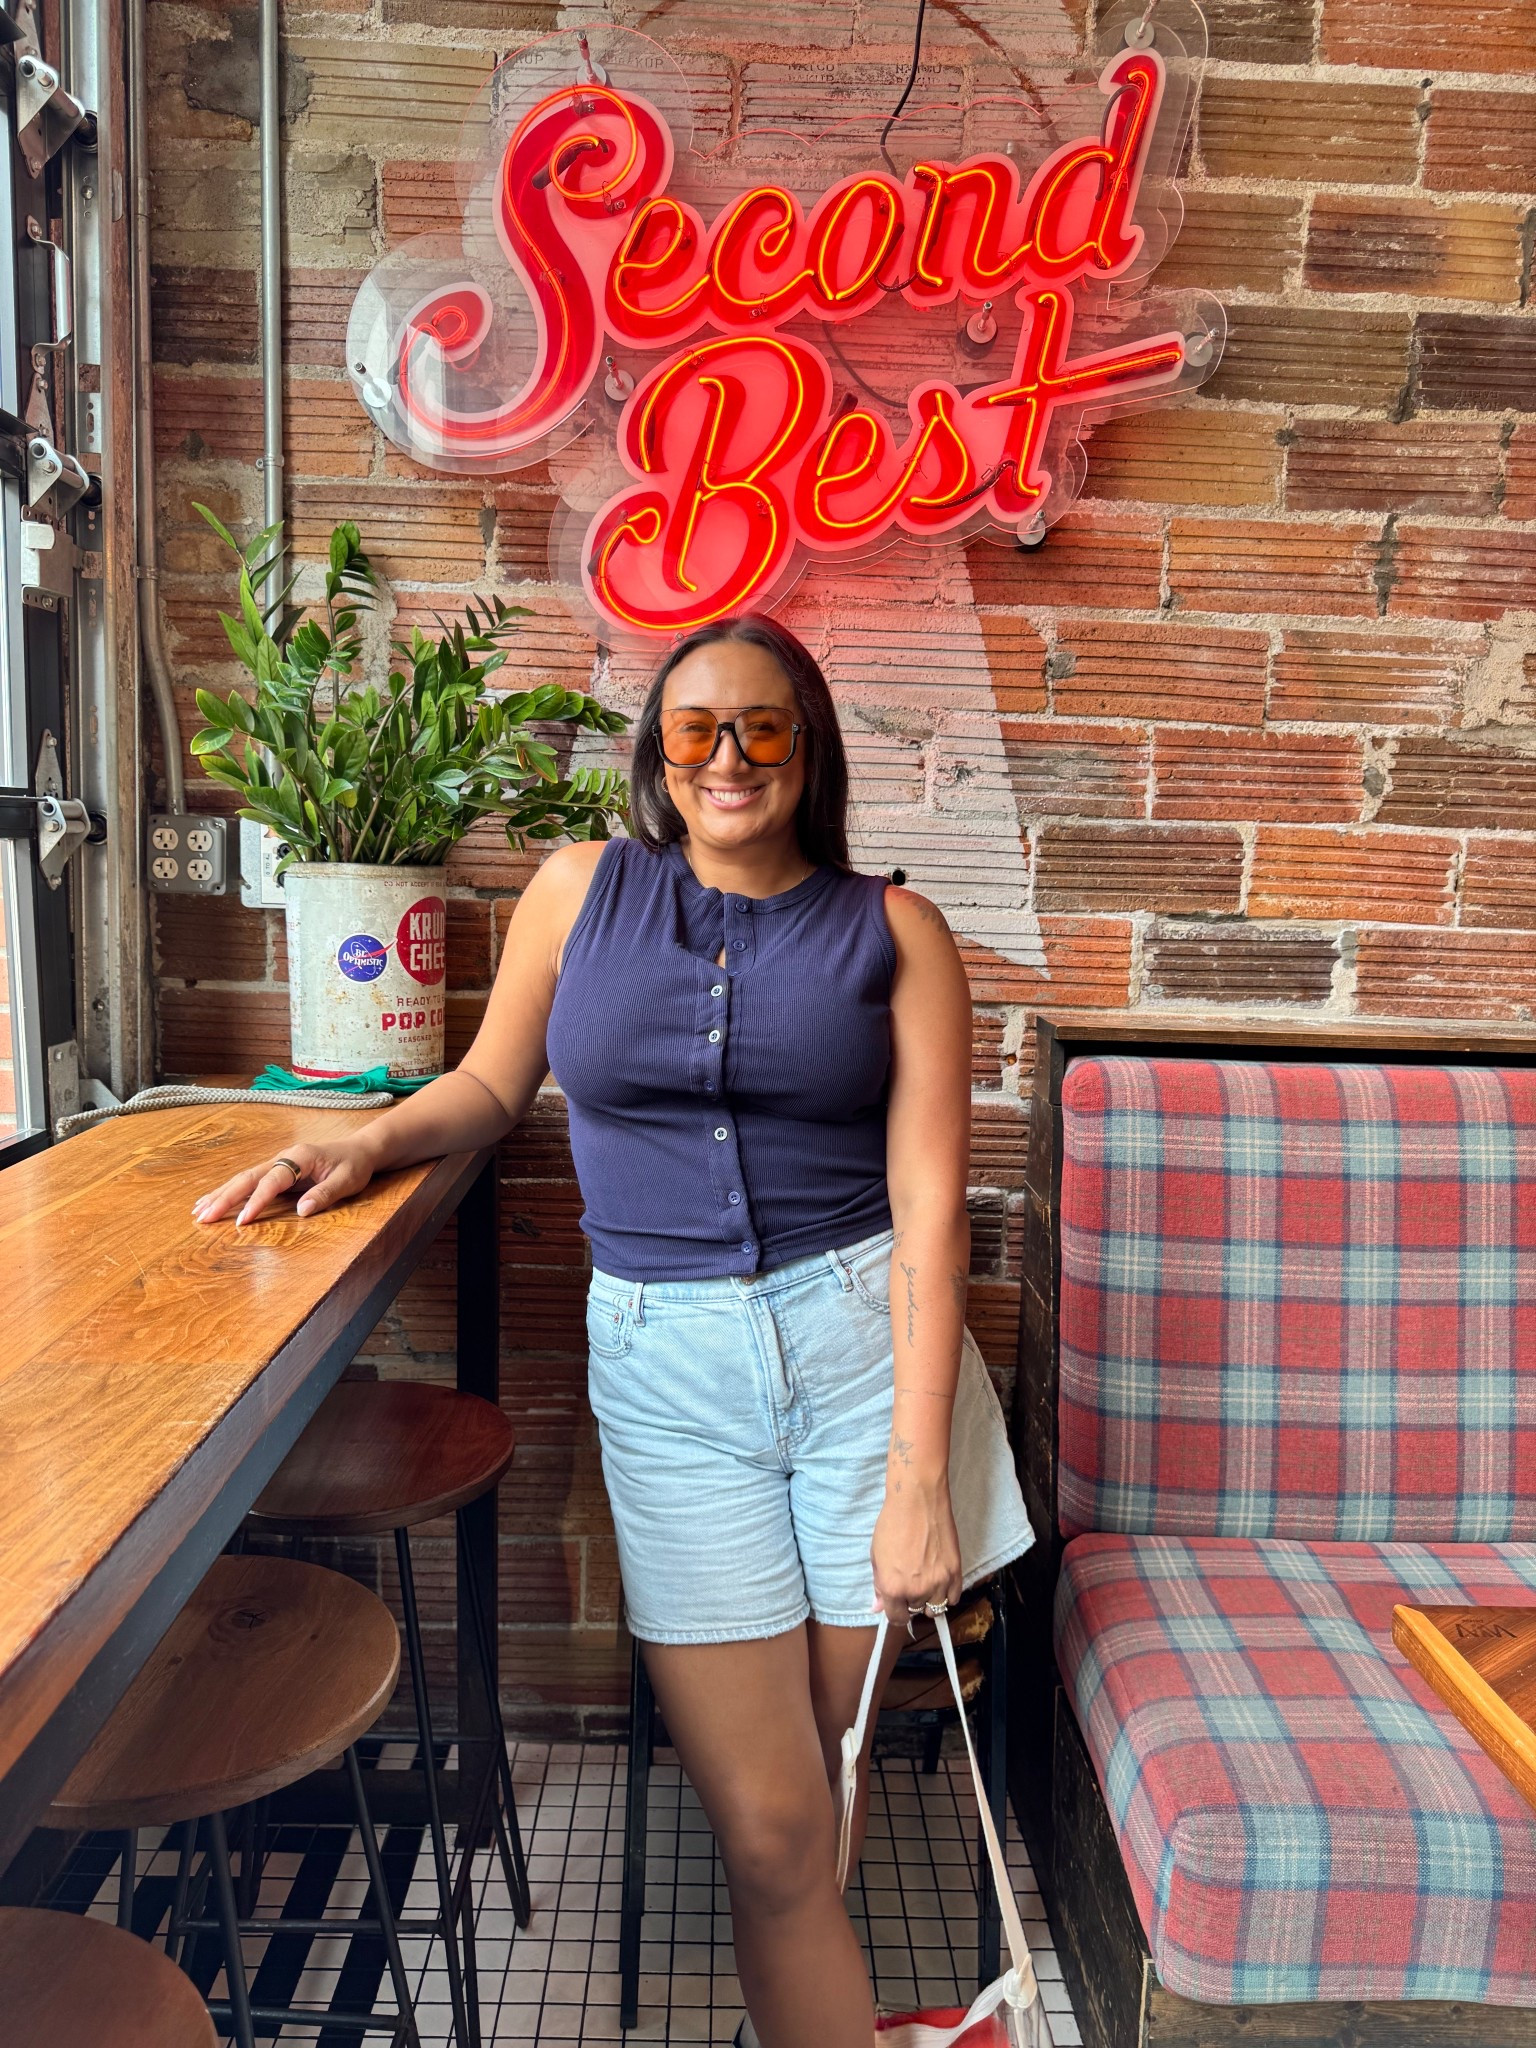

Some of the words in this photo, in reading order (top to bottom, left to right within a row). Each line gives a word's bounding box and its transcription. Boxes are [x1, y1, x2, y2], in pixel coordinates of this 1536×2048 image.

[397, 52, 1160, 442] Second
[592, 288, 1186, 633] Best
[343, 952, 384, 967] OPTIMISTIC
[397, 997, 431, 1006] READY
[382, 1011, 426, 1031] POP
[430, 1007, 446, 1027] CO
[398, 1035, 432, 1043] SEASONED
